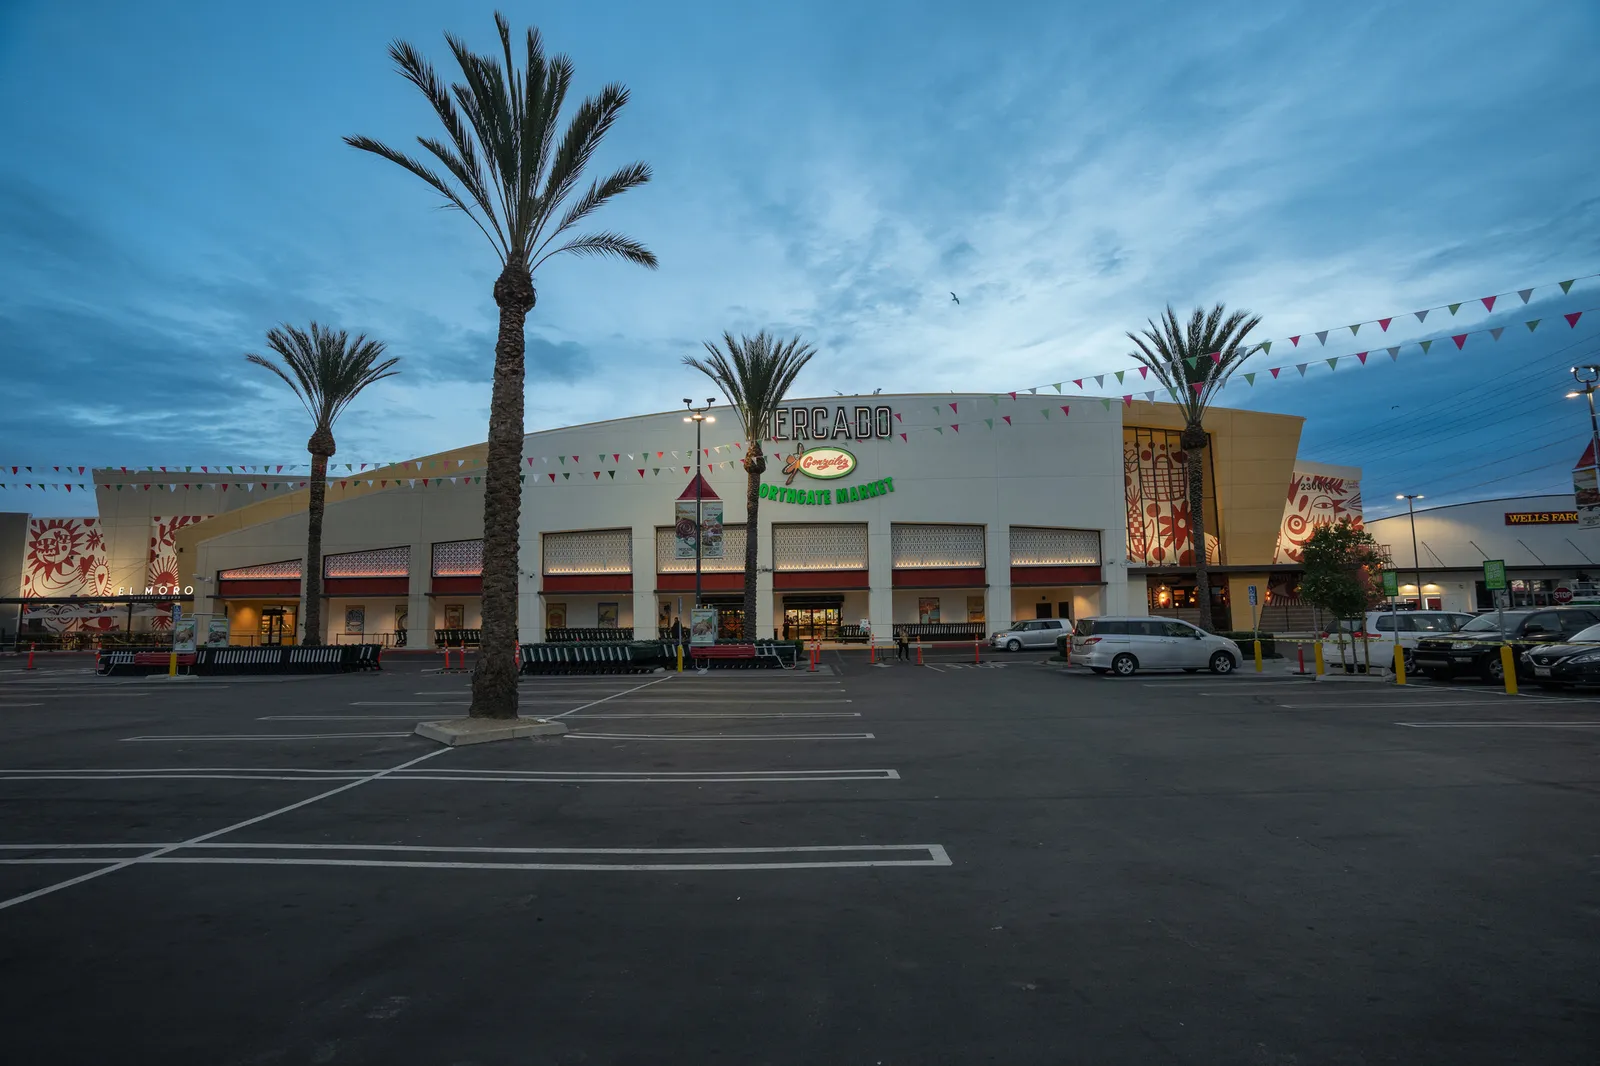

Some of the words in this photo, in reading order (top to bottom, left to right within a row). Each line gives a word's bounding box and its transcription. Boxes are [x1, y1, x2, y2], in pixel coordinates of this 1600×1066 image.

[759, 482, 831, 505] ORTHGATE
[836, 477, 895, 504] MARKET
[1509, 513, 1549, 523] WELLS
[1552, 512, 1578, 522] FAR
[118, 586, 134, 595] EL
[144, 585, 194, 595] MORO
[1555, 591, 1572, 599] STOP
